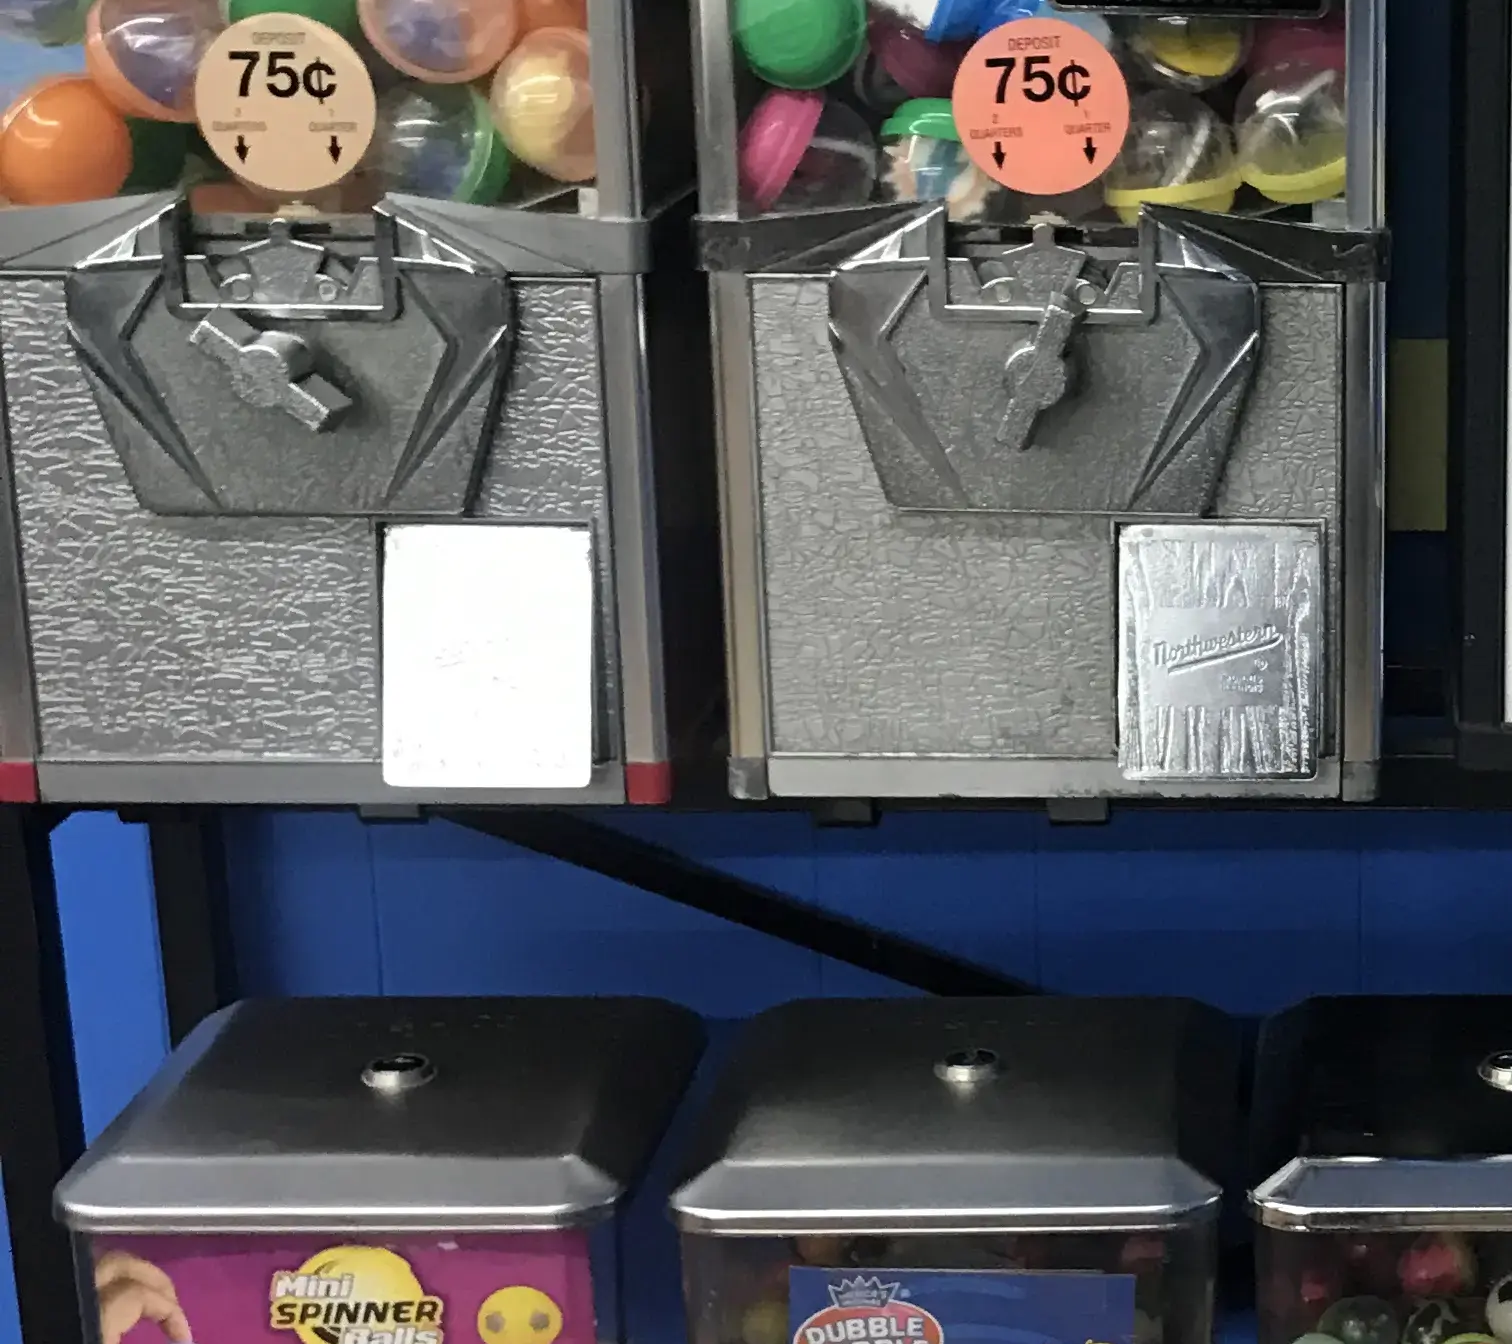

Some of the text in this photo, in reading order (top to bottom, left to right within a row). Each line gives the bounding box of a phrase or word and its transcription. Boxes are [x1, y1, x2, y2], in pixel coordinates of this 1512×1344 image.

[1008, 36, 1061, 51] DEPOSIT
[229, 51, 337, 105] 75¢
[985, 55, 1092, 107] 75¢
[275, 1273, 354, 1298] Mini
[276, 1300, 439, 1325] SPINNER
